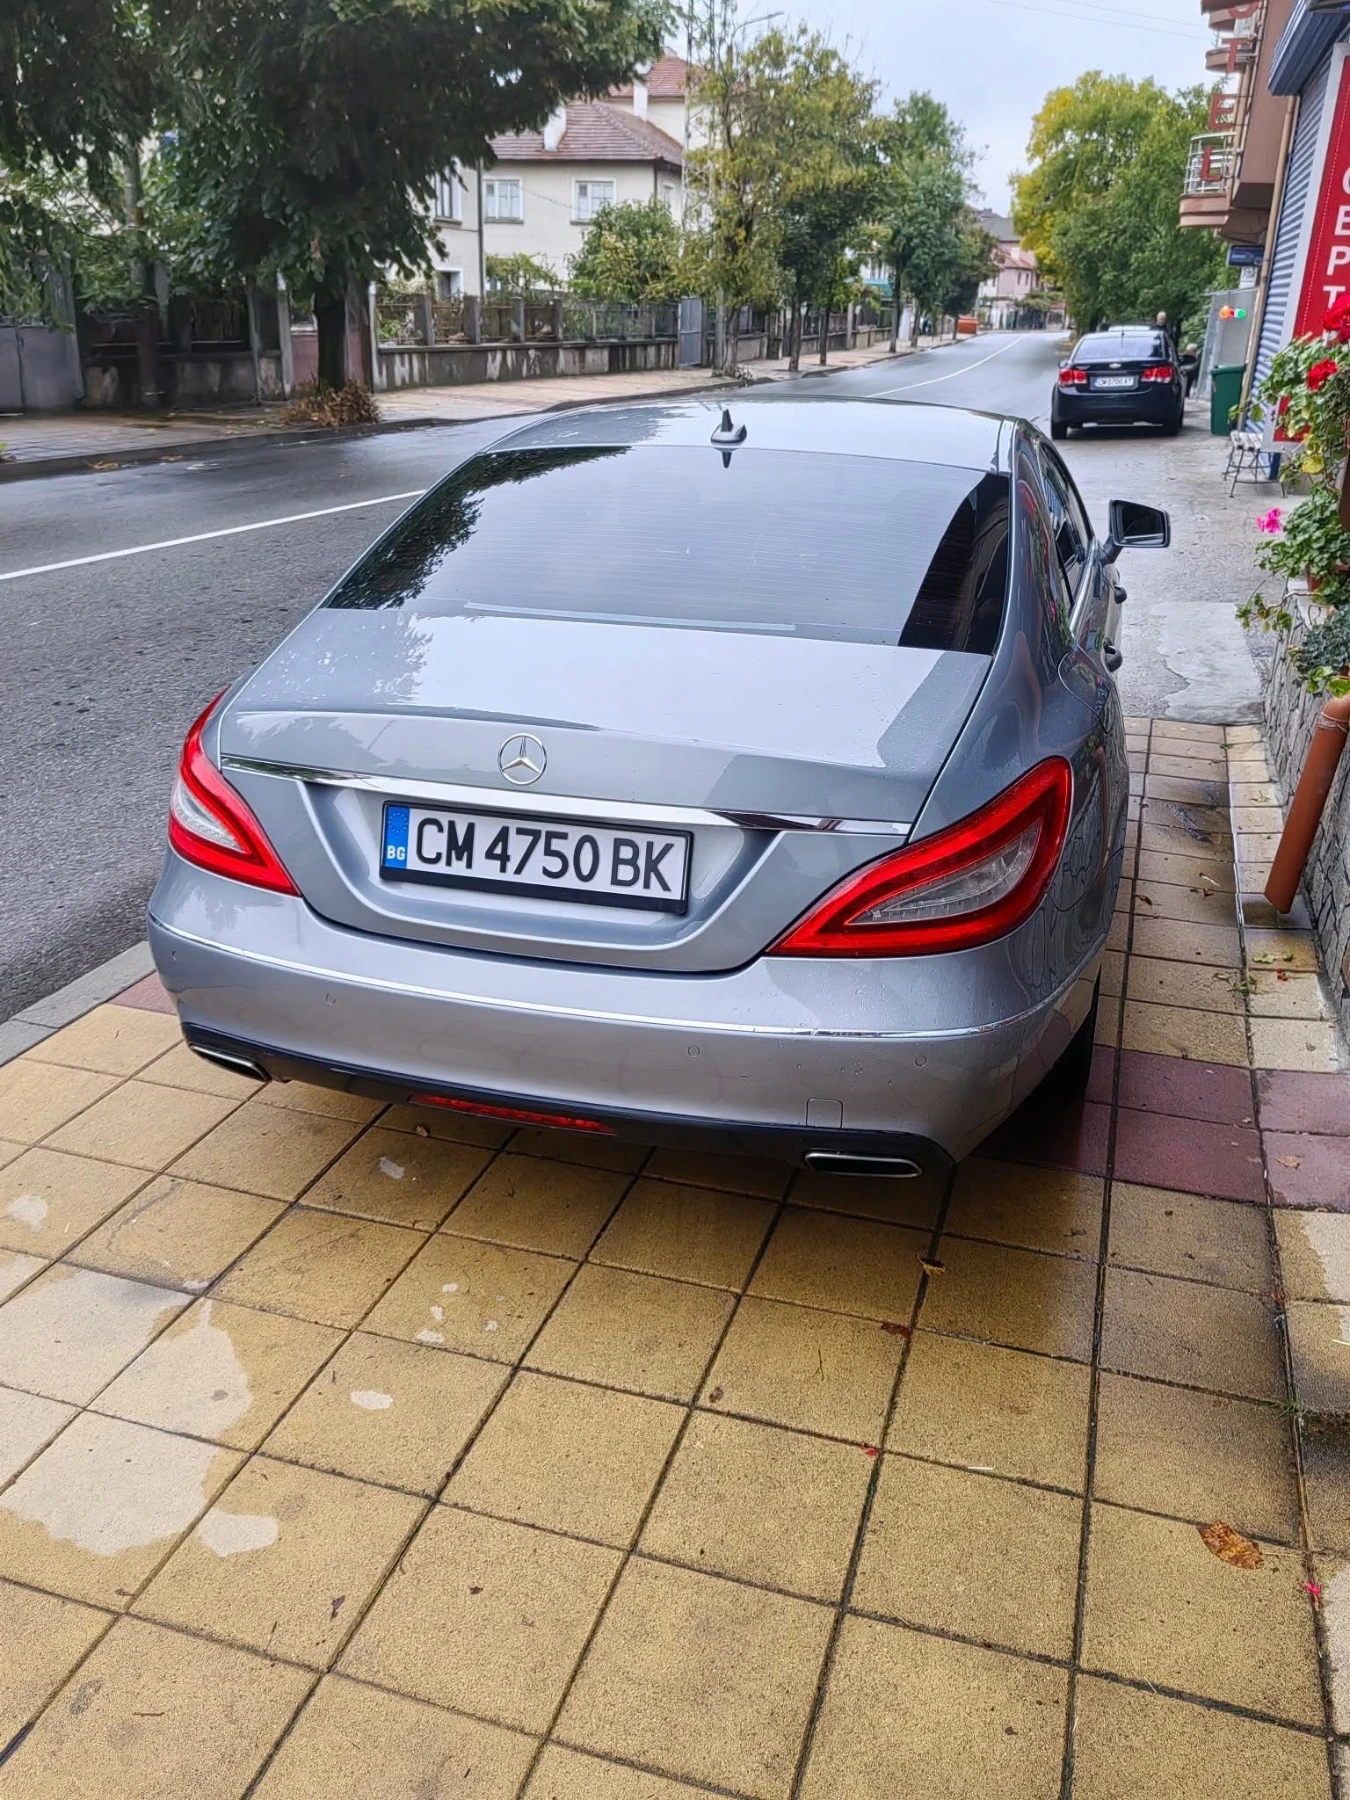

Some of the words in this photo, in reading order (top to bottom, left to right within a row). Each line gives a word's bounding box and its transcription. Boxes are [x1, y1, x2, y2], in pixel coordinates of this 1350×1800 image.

[386, 845, 406, 860] BG
[416, 817, 475, 869] CM
[484, 825, 600, 883] 4750
[610, 837, 674, 892] BK
